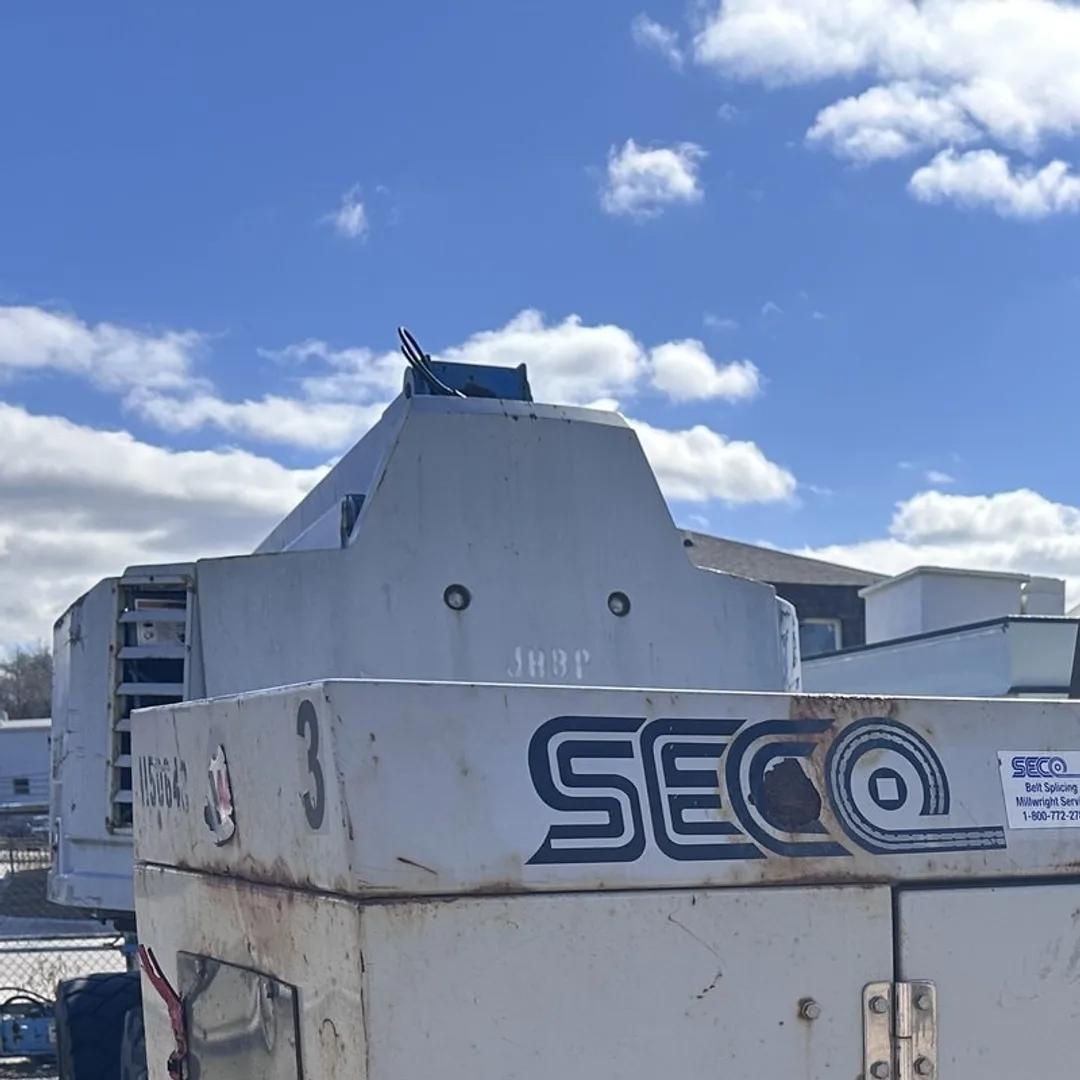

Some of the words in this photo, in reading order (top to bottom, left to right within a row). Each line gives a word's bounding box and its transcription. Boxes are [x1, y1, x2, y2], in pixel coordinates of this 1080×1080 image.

[296, 698, 326, 830] 3
[525, 715, 1006, 864] SECO
[1024, 781, 1043, 793] Belt
[1044, 782, 1079, 795] Splicing
[1016, 796, 1060, 809] Millwright
